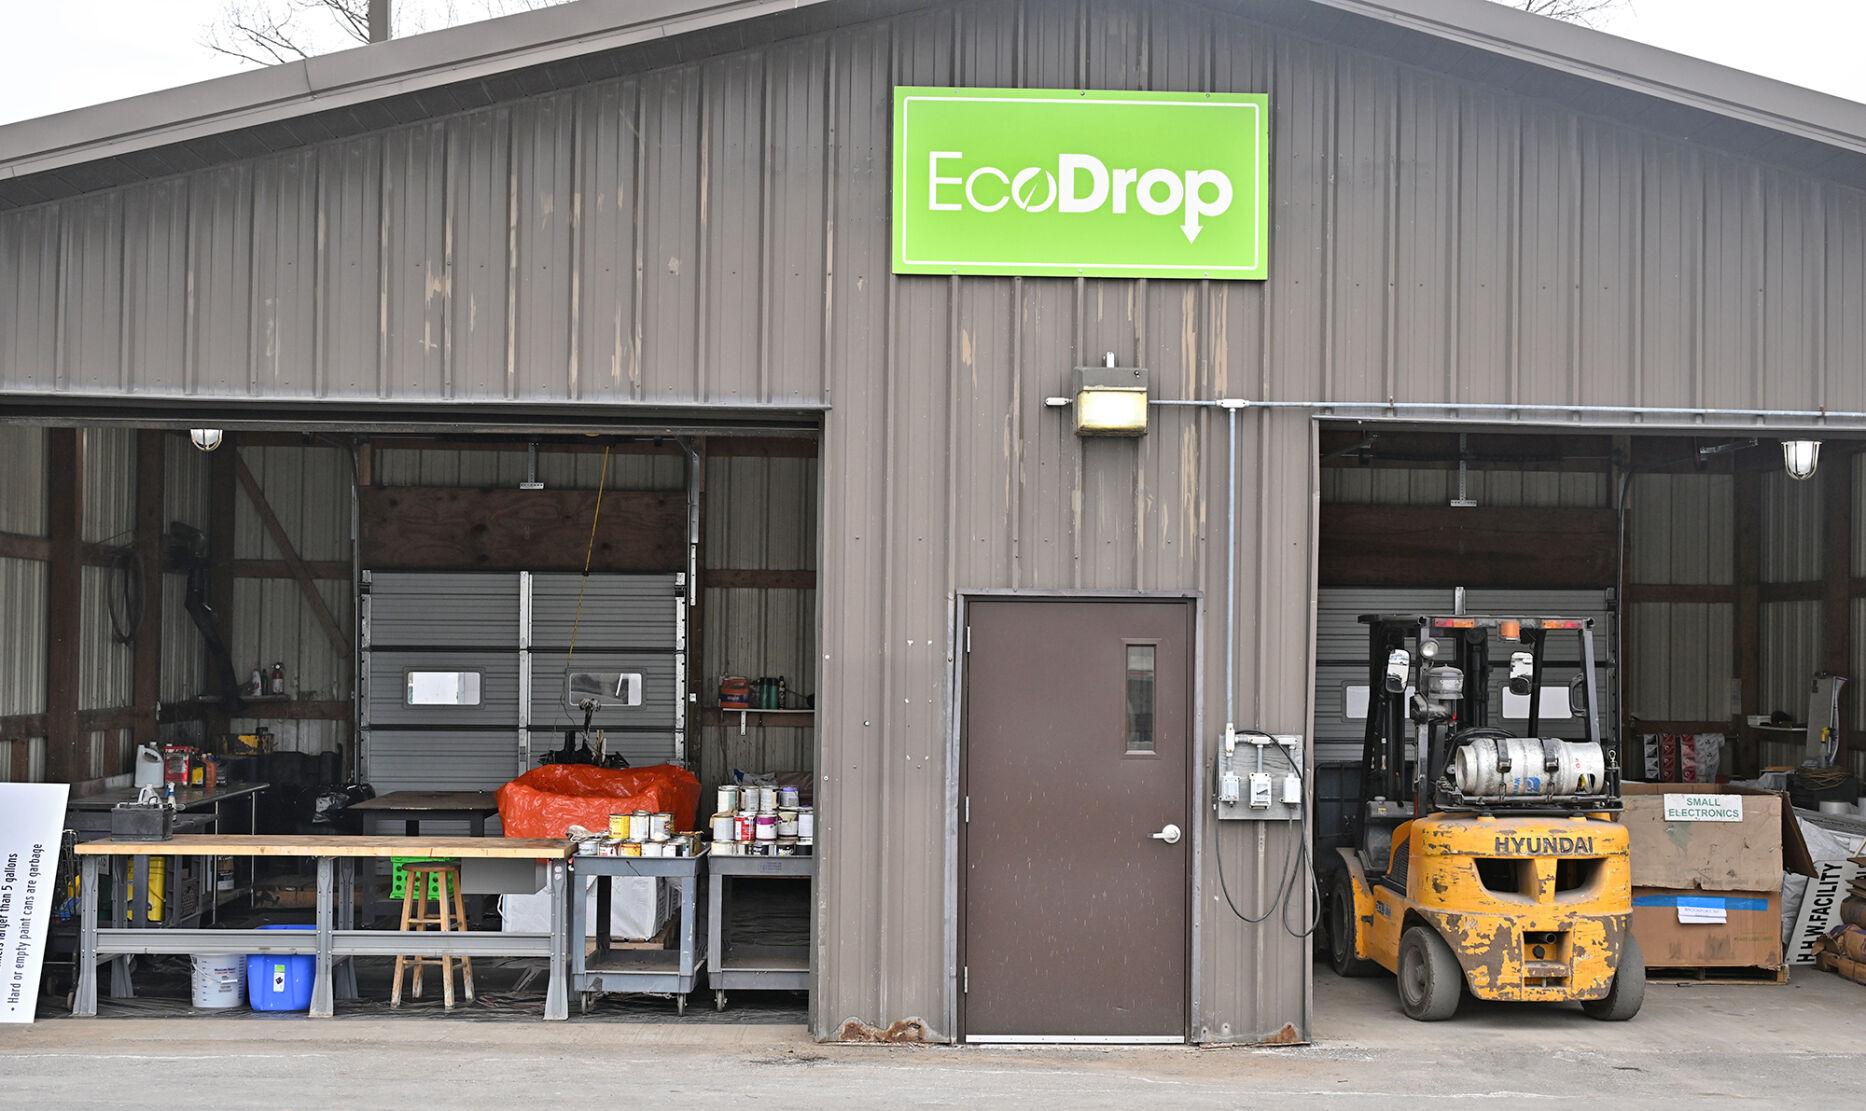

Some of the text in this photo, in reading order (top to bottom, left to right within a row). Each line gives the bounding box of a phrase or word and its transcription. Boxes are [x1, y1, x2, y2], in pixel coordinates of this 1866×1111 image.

[929, 151, 1233, 244] EcoDrop
[1668, 808, 1740, 818] ELECTRONICS
[1686, 797, 1721, 807] SMALL
[1494, 836, 1594, 854] HYUNDAI
[4, 853, 18, 883] gallons
[0, 893, 12, 912] than
[1796, 863, 1843, 963] HHW.FACILITY
[7, 843, 45, 1004] Hard or empty paint cans are garbage
